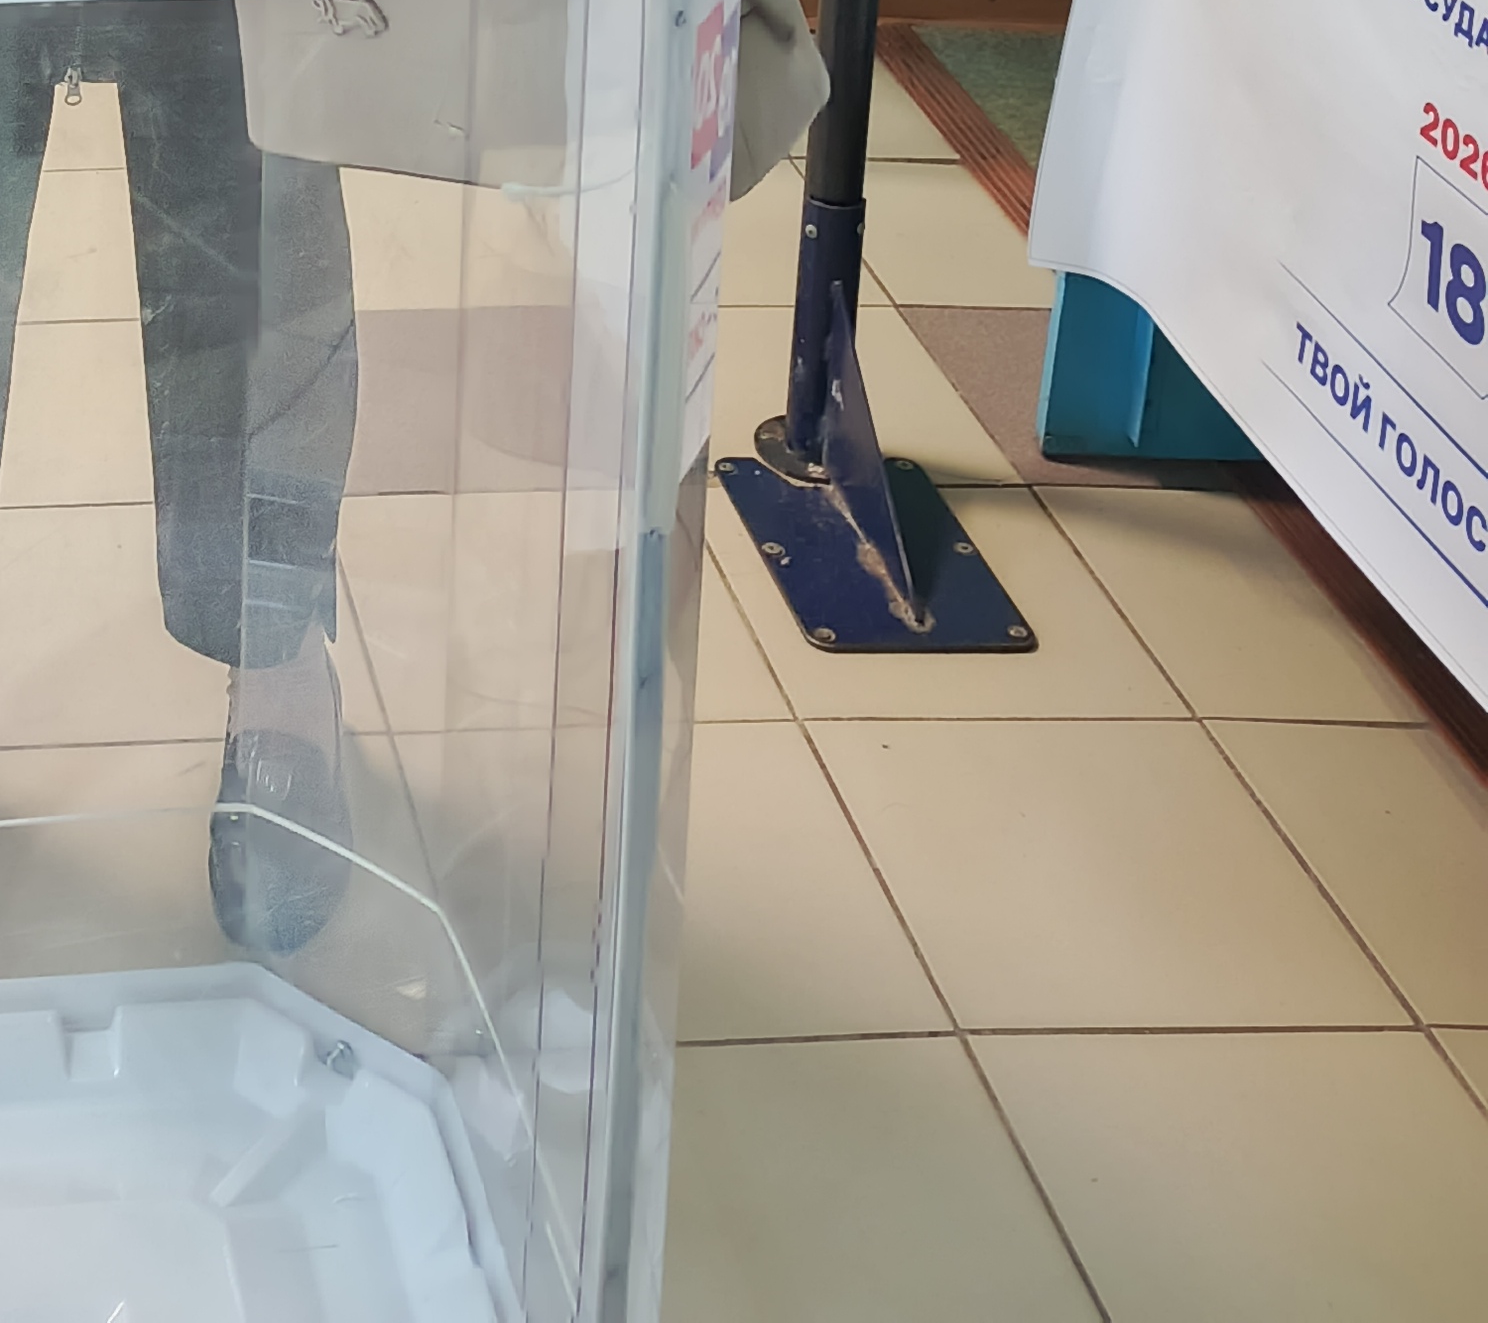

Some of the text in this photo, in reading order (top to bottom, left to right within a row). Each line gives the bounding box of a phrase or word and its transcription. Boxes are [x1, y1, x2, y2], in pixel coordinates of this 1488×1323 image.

[1420, 219, 1487, 345] 18
[1296, 321, 1488, 552] ТВОЙ ГОЛОС
